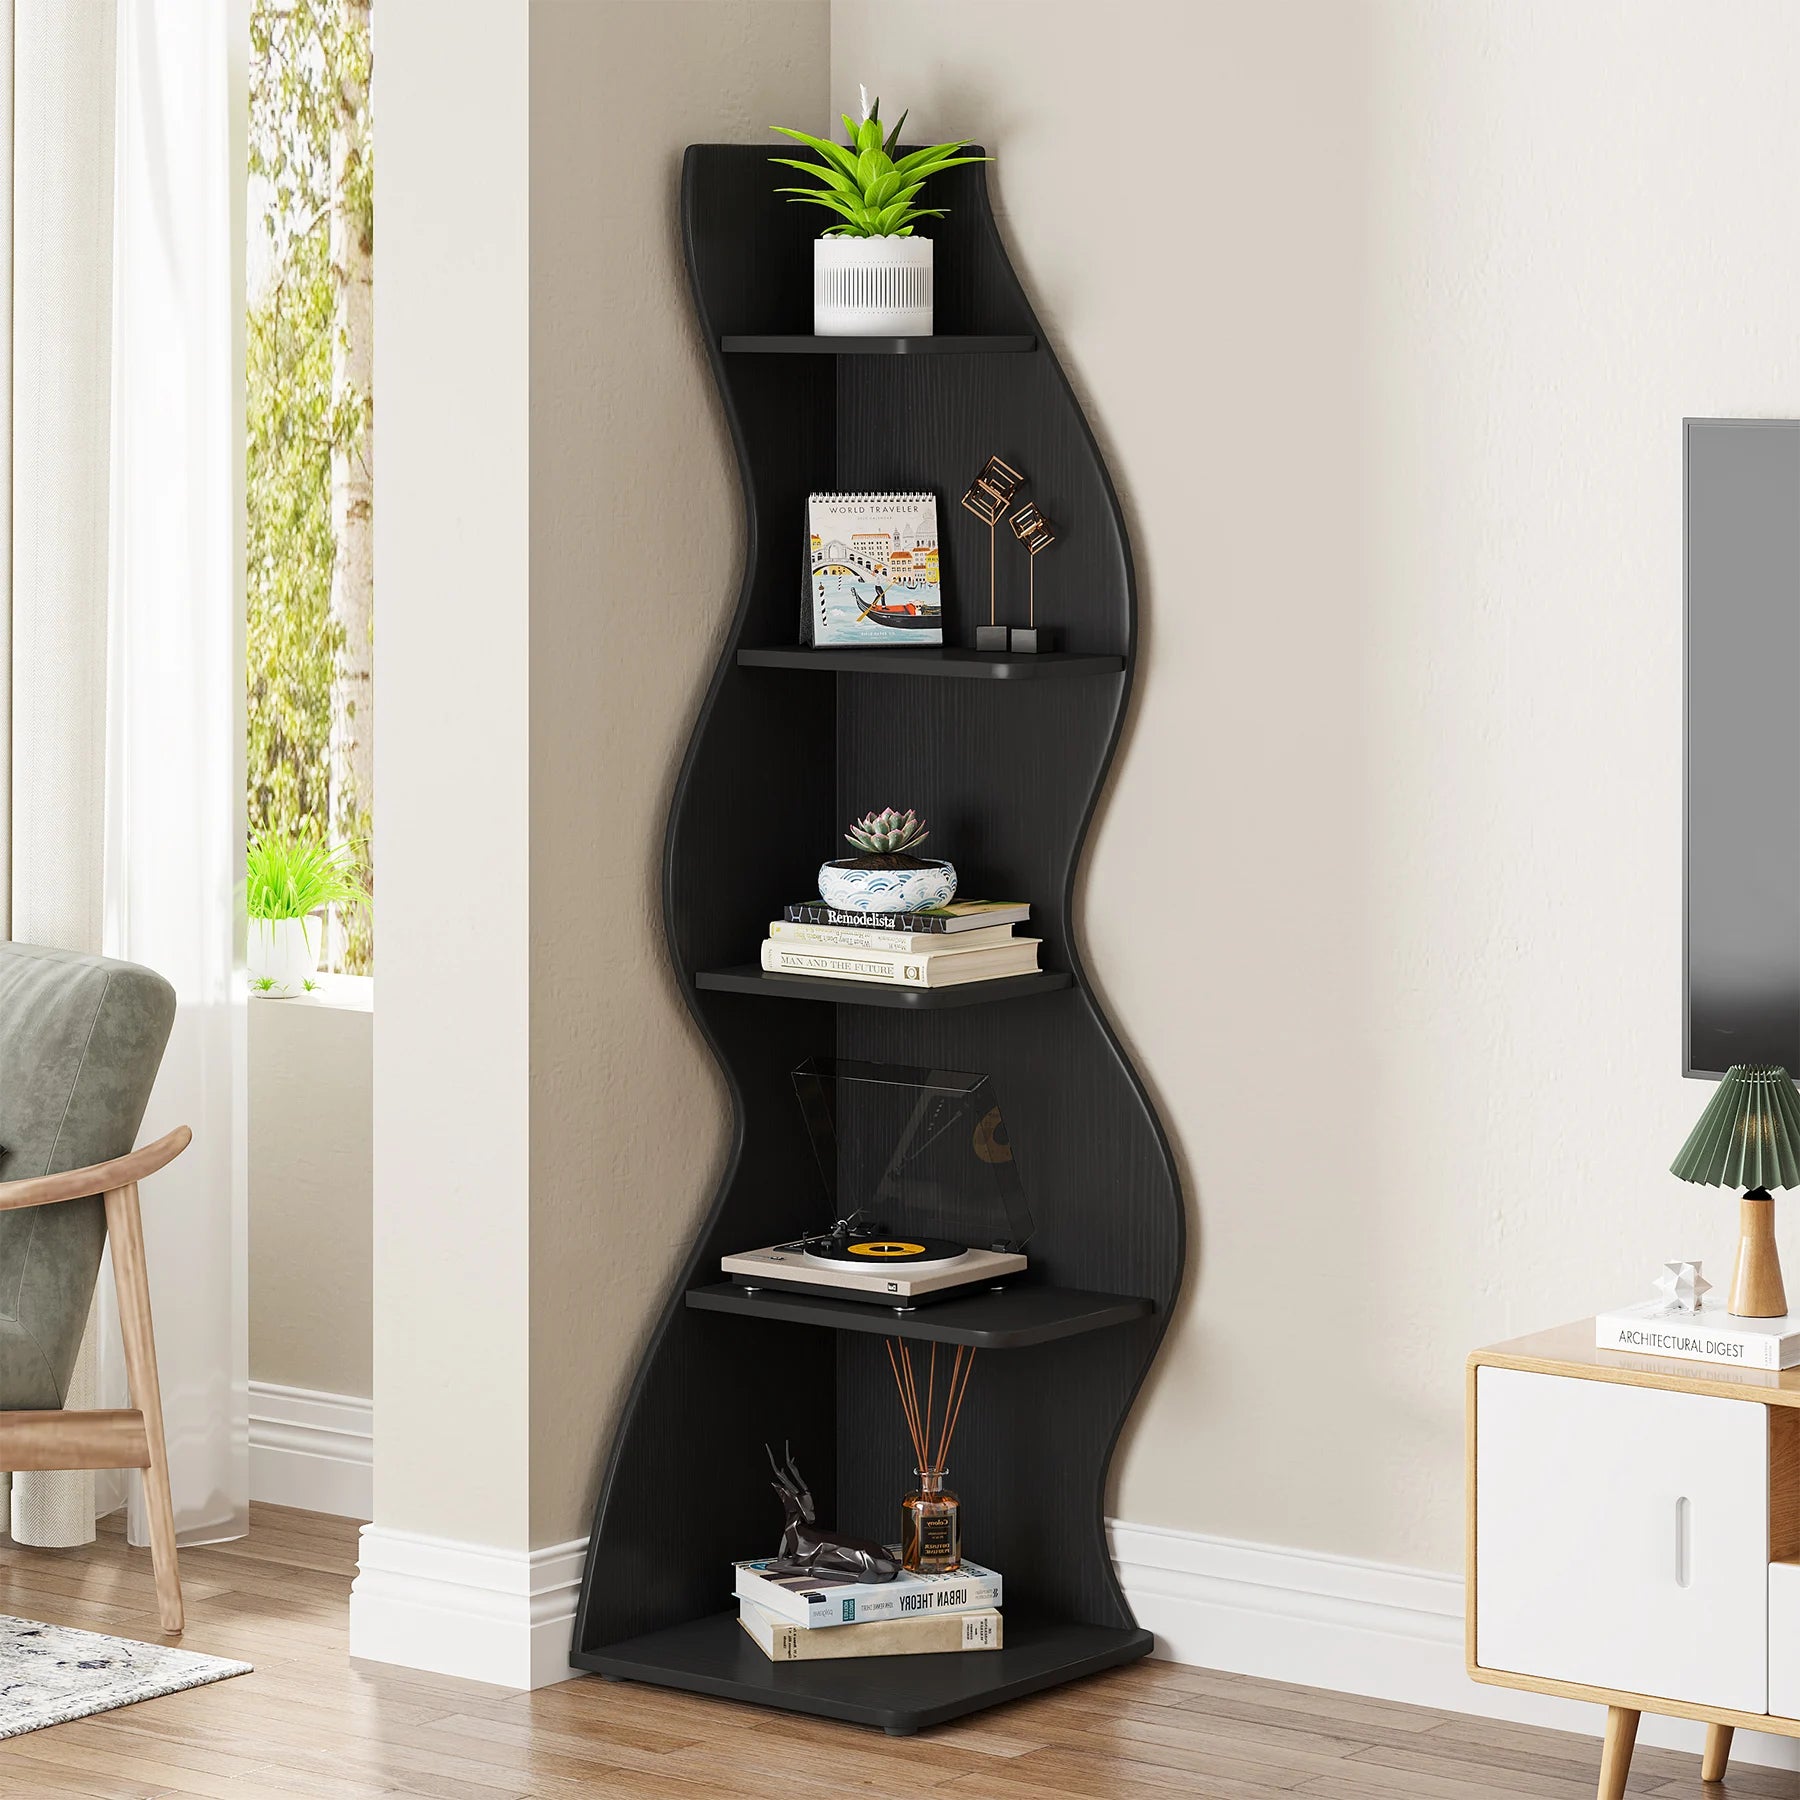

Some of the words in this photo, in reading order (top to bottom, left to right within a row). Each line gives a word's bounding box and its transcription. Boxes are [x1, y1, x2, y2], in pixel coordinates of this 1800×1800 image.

[829, 506, 865, 514] WORLD
[870, 505, 919, 513] TRAVELER
[828, 910, 896, 928] Remodelista
[781, 955, 803, 966] MAN
[807, 958, 828, 969] AND
[831, 961, 852, 971] THE
[855, 964, 894, 975] FUTURE
[1619, 1330, 1703, 1353] ARCHITECTURAL
[1706, 1341, 1744, 1358] DIGEST
